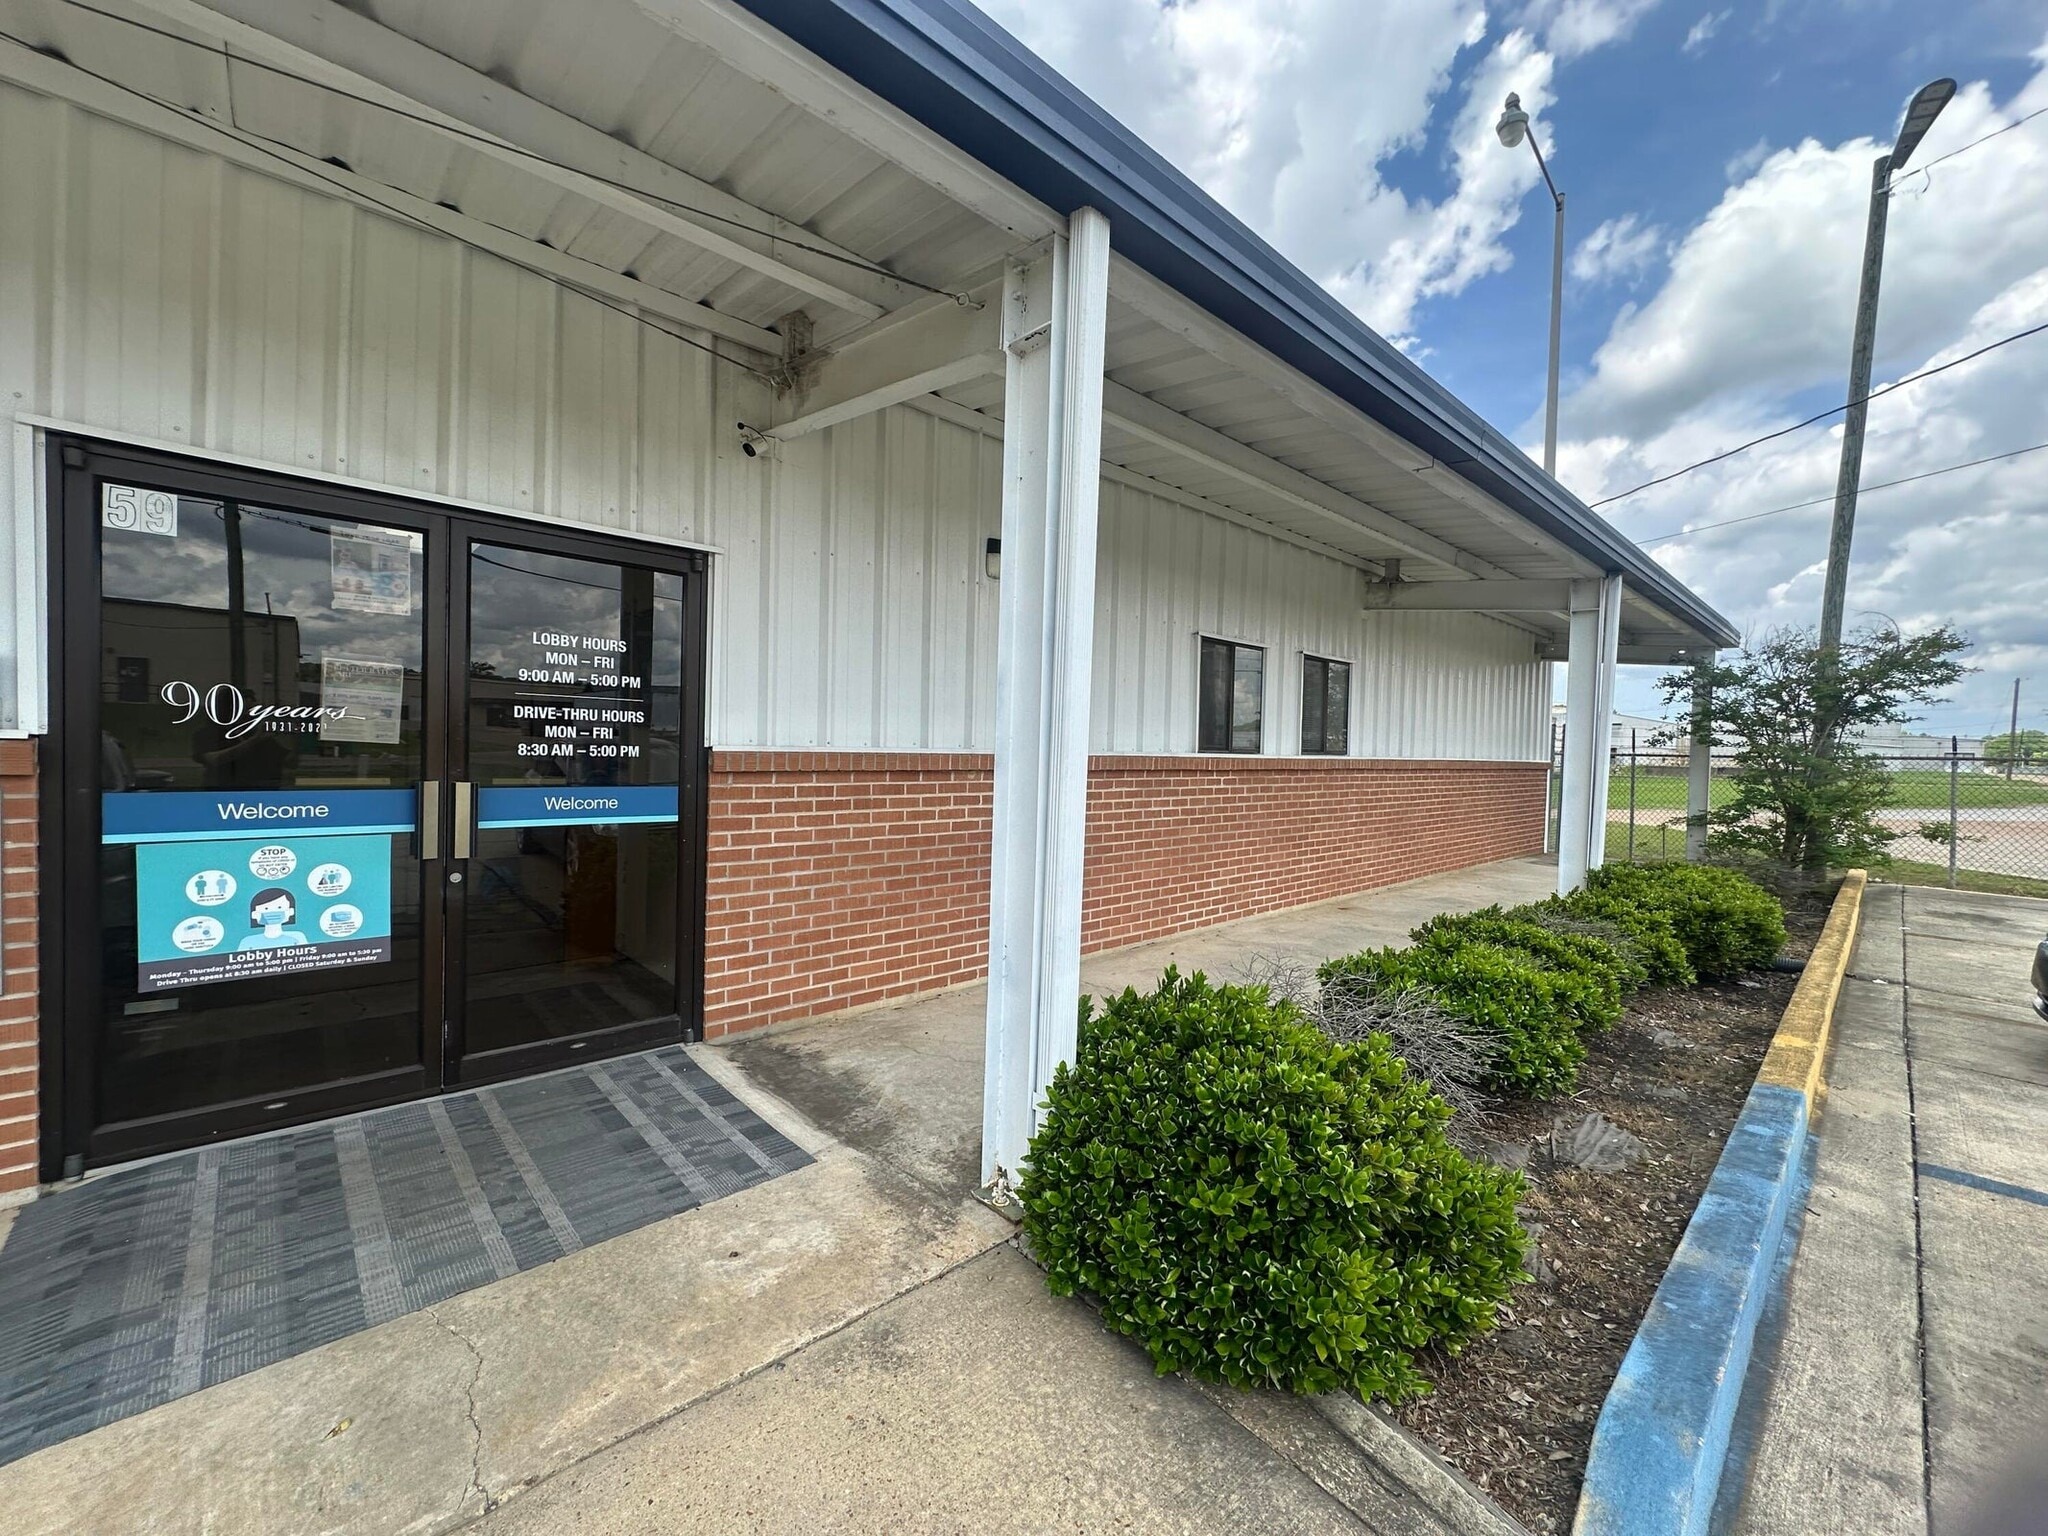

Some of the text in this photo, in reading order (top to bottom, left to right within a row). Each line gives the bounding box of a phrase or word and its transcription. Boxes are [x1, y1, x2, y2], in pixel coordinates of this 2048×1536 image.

[107, 486, 174, 533] 59
[532, 632, 627, 652] LOBBY HOURS
[546, 652, 578, 666] MON
[594, 656, 614, 669] FRI
[518, 668, 548, 682] 9:00
[552, 671, 574, 684] AM
[590, 673, 618, 687] 5:00
[621, 676, 641, 688] PM
[161, 681, 244, 726] 90
[225, 704, 366, 740] years
[514, 706, 644, 724] DRIVE-THRU HOURS
[544, 725, 576, 738] MON
[592, 728, 613, 740] FRI
[518, 744, 548, 756] 8:30
[551, 744, 574, 757] AM
[589, 745, 617, 757] 5:00
[620, 746, 640, 758] PM
[217, 802, 330, 820] Welcome
[544, 796, 618, 810] Welcome
[229, 946, 318, 963] Lobby Hours
[149, 971, 181, 980] Monday
[189, 966, 224, 975] Thursday
[264, 964, 282, 972] daily
[288, 962, 314, 970] CLOSED
[315, 958, 345, 966] Saturday
